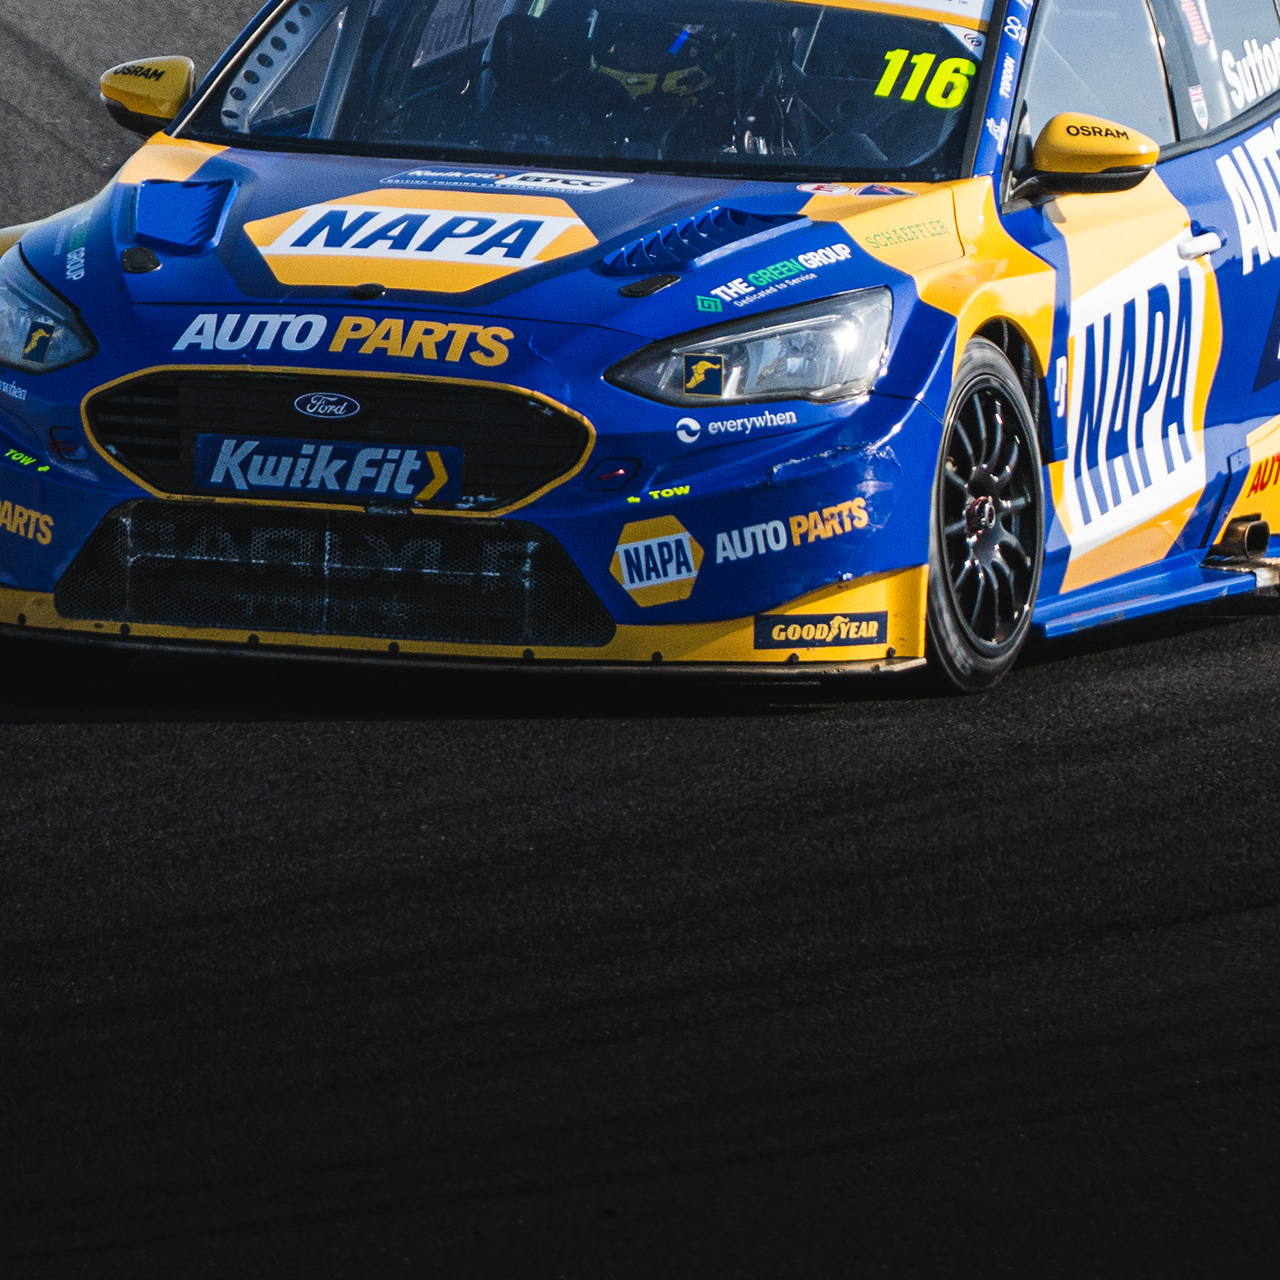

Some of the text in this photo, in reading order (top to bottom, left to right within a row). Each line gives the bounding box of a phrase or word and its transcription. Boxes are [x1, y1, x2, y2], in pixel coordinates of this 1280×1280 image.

[113, 65, 166, 82] OSRAM
[874, 48, 976, 109] 116
[1066, 124, 1130, 141] OSRAM
[518, 175, 607, 188] BTCC
[291, 209, 545, 259] NAPA
[865, 219, 951, 250] SCHAEFFLER
[710, 243, 853, 302] THE GREEN GROUP
[733, 272, 818, 308] Dedicated to Service
[172, 314, 515, 368] AUTO PARTS
[306, 394, 348, 415] Ford
[1073, 261, 1198, 527] NAPA
[708, 409, 797, 435] everywhen
[5, 448, 36, 466] TOW
[649, 485, 690, 499] TOW
[715, 497, 871, 564] AUTO PARTS
[623, 538, 693, 584] NAPA
[771, 615, 879, 642] GOODYEAR
